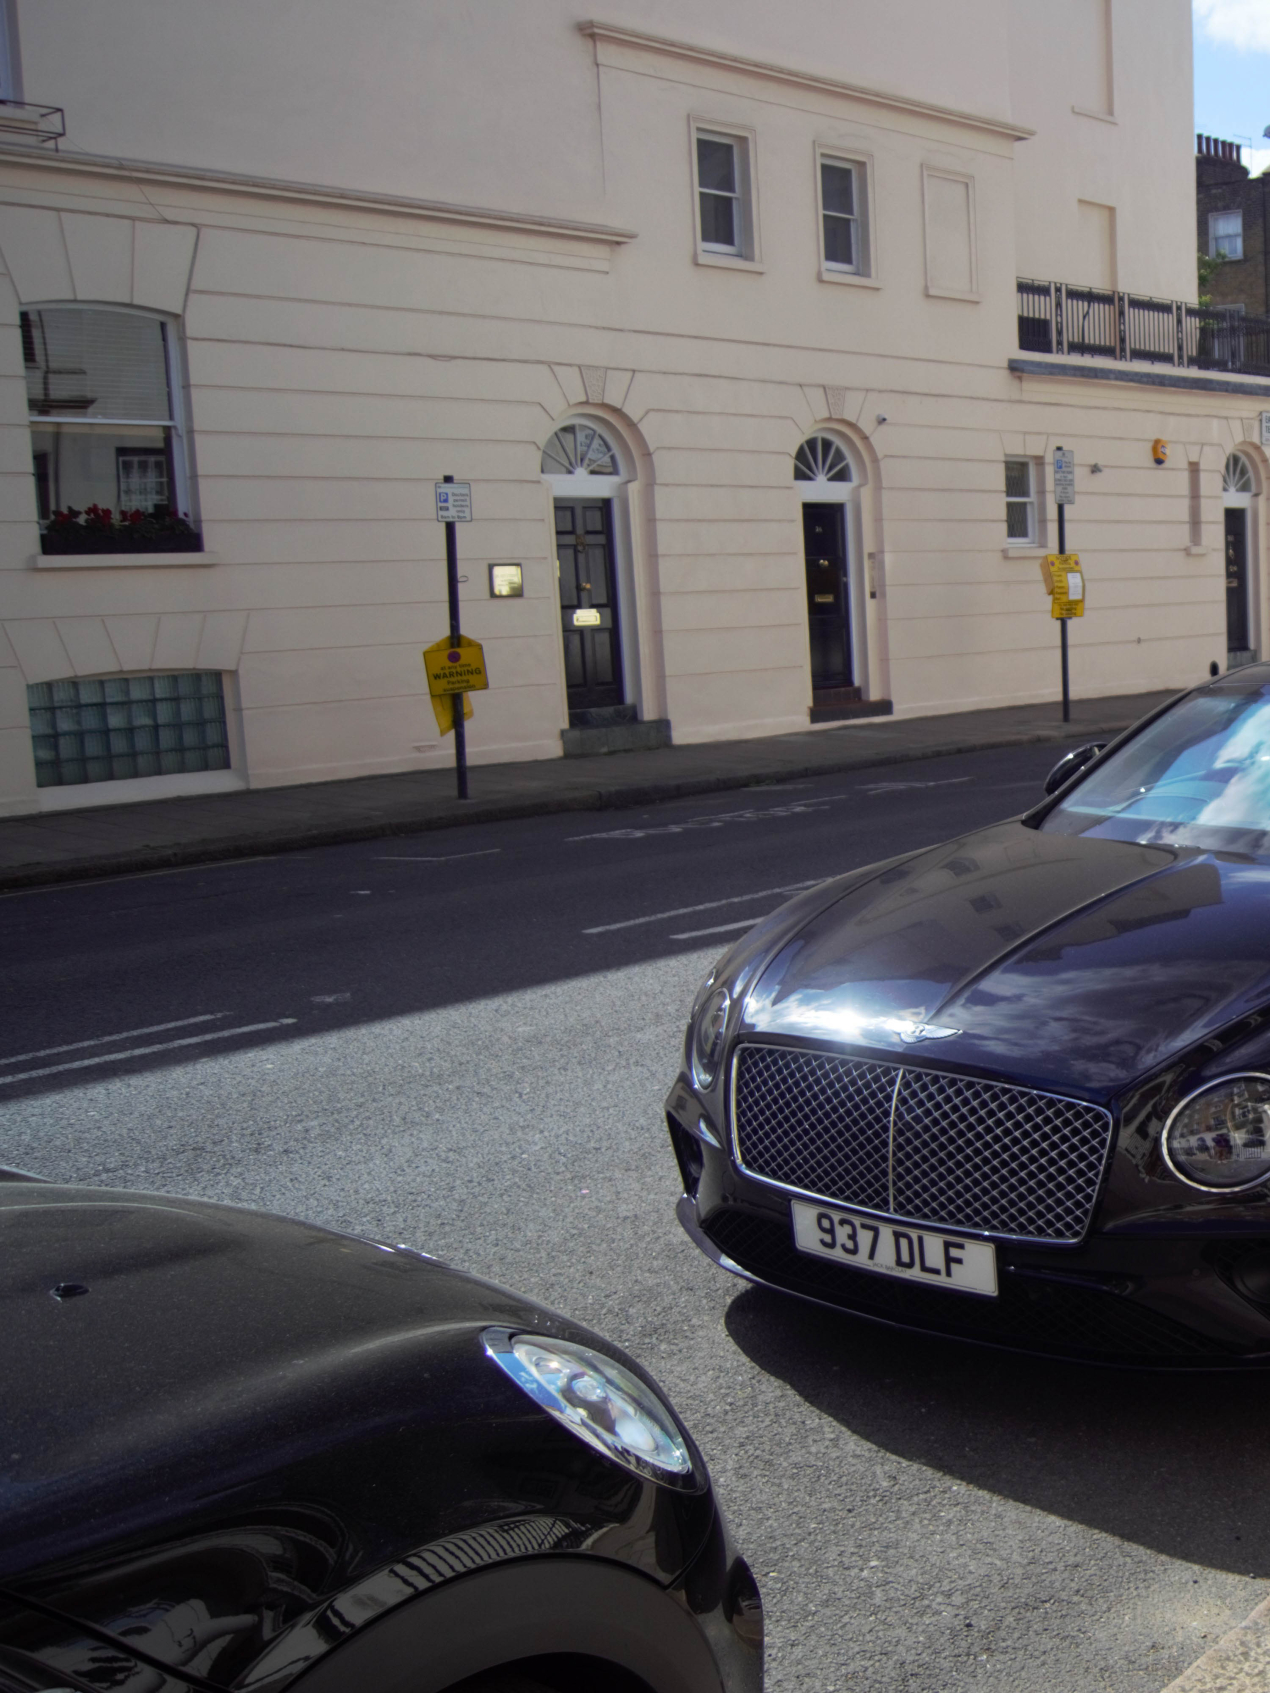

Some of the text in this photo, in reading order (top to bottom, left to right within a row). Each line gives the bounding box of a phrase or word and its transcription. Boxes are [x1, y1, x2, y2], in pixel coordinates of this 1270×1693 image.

[432, 667, 482, 681] WARNING
[446, 678, 470, 686] Parking
[816, 1211, 966, 1278] 937 DLF
[872, 1261, 907, 1274] JACK BARCLAY
